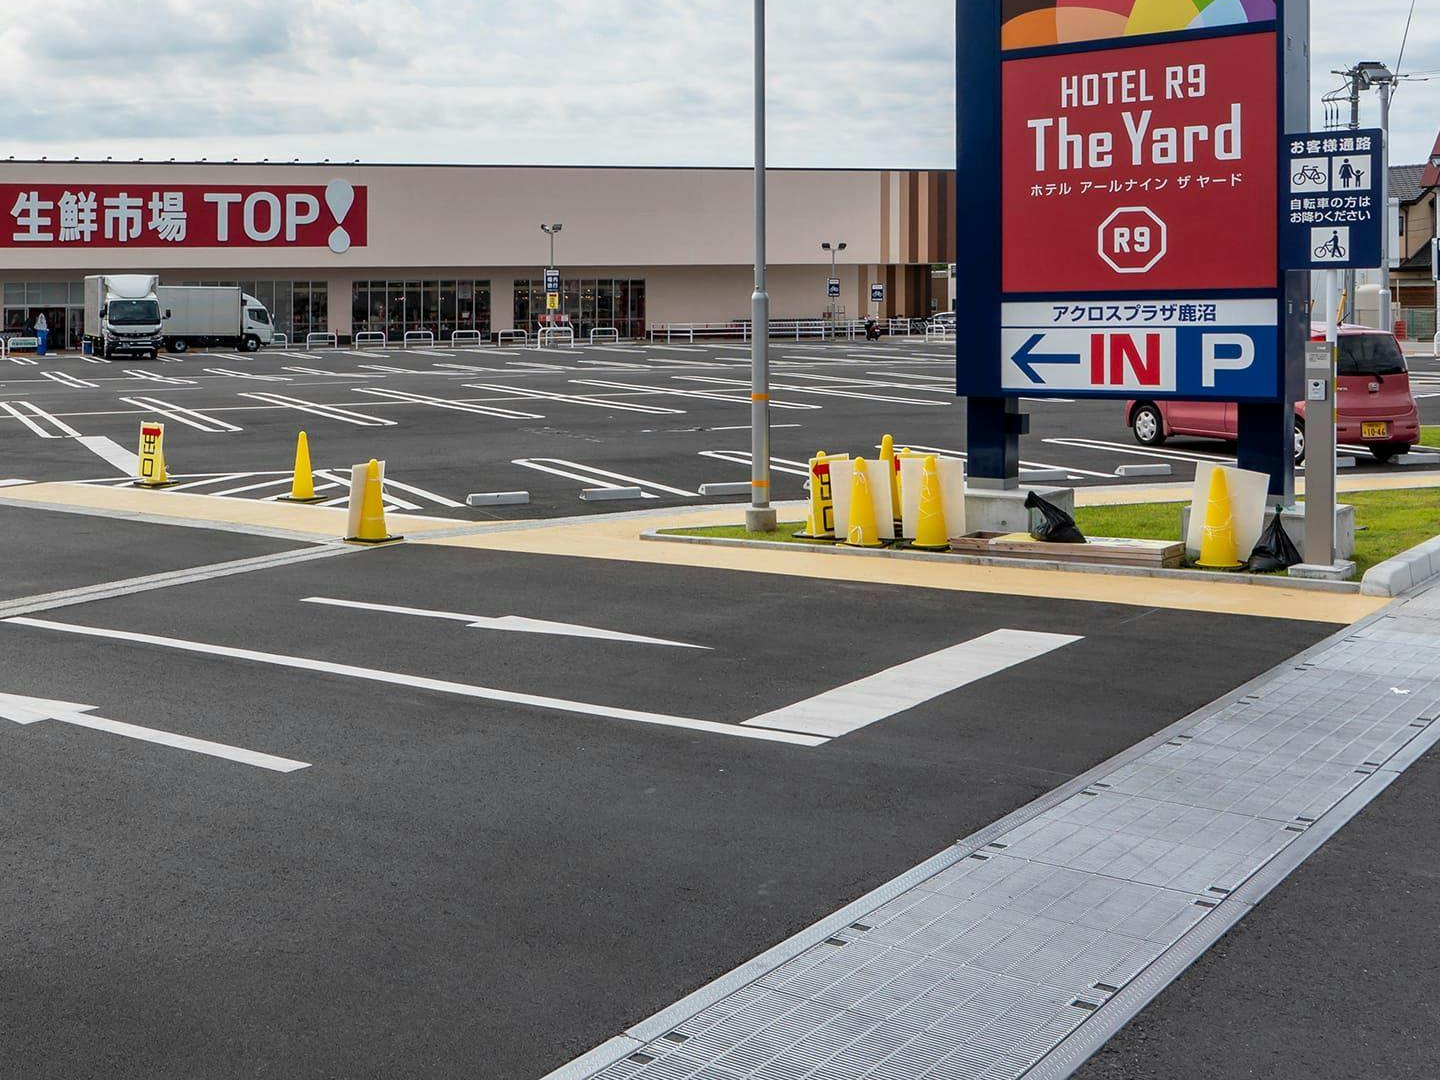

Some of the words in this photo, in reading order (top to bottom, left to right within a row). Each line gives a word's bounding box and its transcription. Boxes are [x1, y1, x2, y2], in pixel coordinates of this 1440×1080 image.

[1061, 69, 1153, 108] HOTEL
[1166, 63, 1206, 99] R9
[1027, 116, 1113, 171] The
[1121, 102, 1242, 166] Yard
[1290, 136, 1371, 154] お客様通路
[1030, 182, 1072, 196] ホテル
[1080, 177, 1168, 194] アールナイン
[1177, 175, 1191, 189] ザ
[1196, 173, 1243, 188] ヤード
[10, 190, 187, 242] 生鮮市場
[1290, 196, 1371, 210] 自転車の方は
[1290, 210, 1371, 223] お降りください
[1114, 226, 1151, 253] R9
[1052, 303, 1217, 322] アクロスプラザ鹿沼
[1090, 333, 1161, 386] IN
[1202, 333, 1255, 387] P
